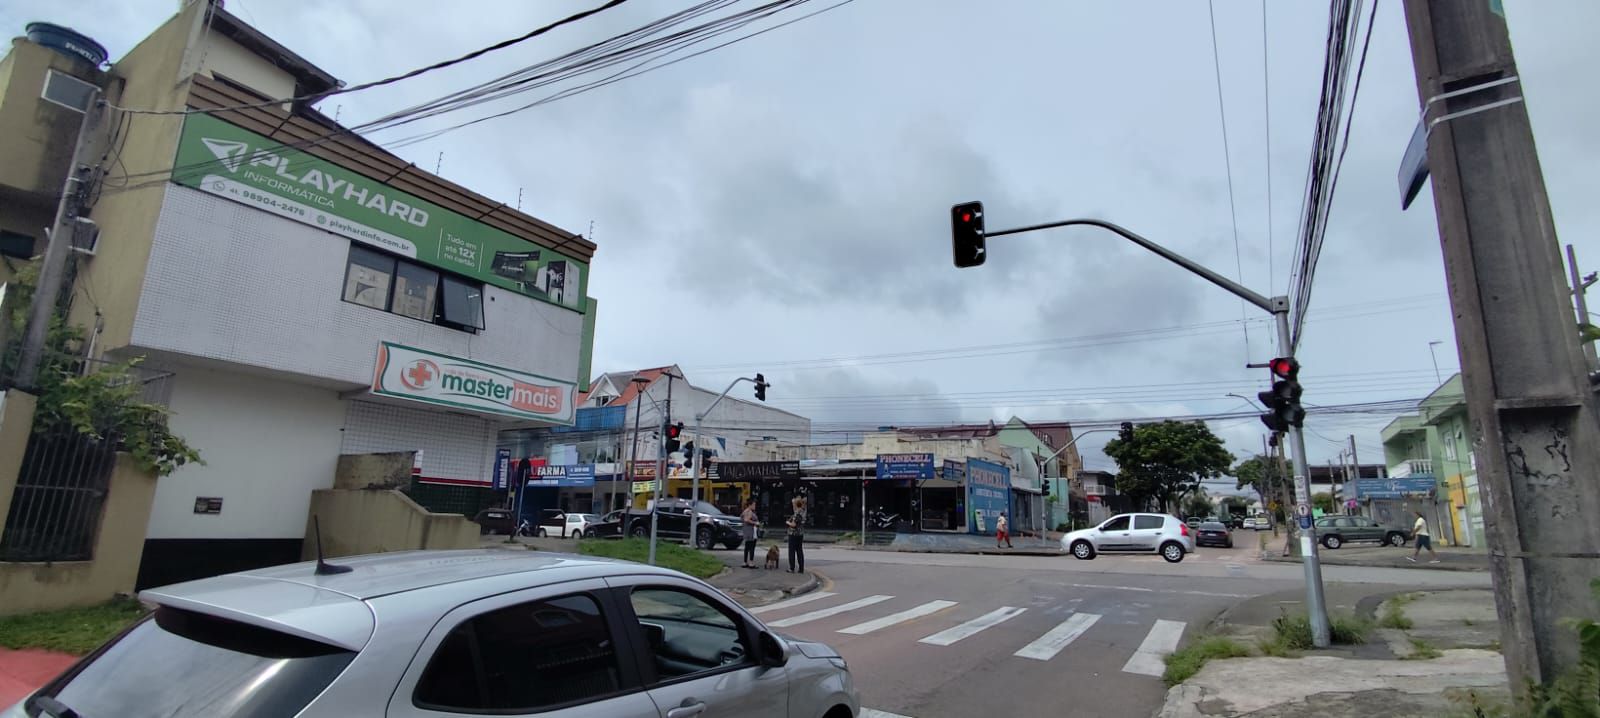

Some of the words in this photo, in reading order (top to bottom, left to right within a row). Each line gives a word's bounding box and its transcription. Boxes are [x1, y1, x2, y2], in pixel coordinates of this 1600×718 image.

[249, 147, 429, 228] PLAYHARD
[329, 218, 410, 251] playhardinfo.com.br
[458, 247, 475, 259] 12X
[537, 466, 566, 476] FARMA
